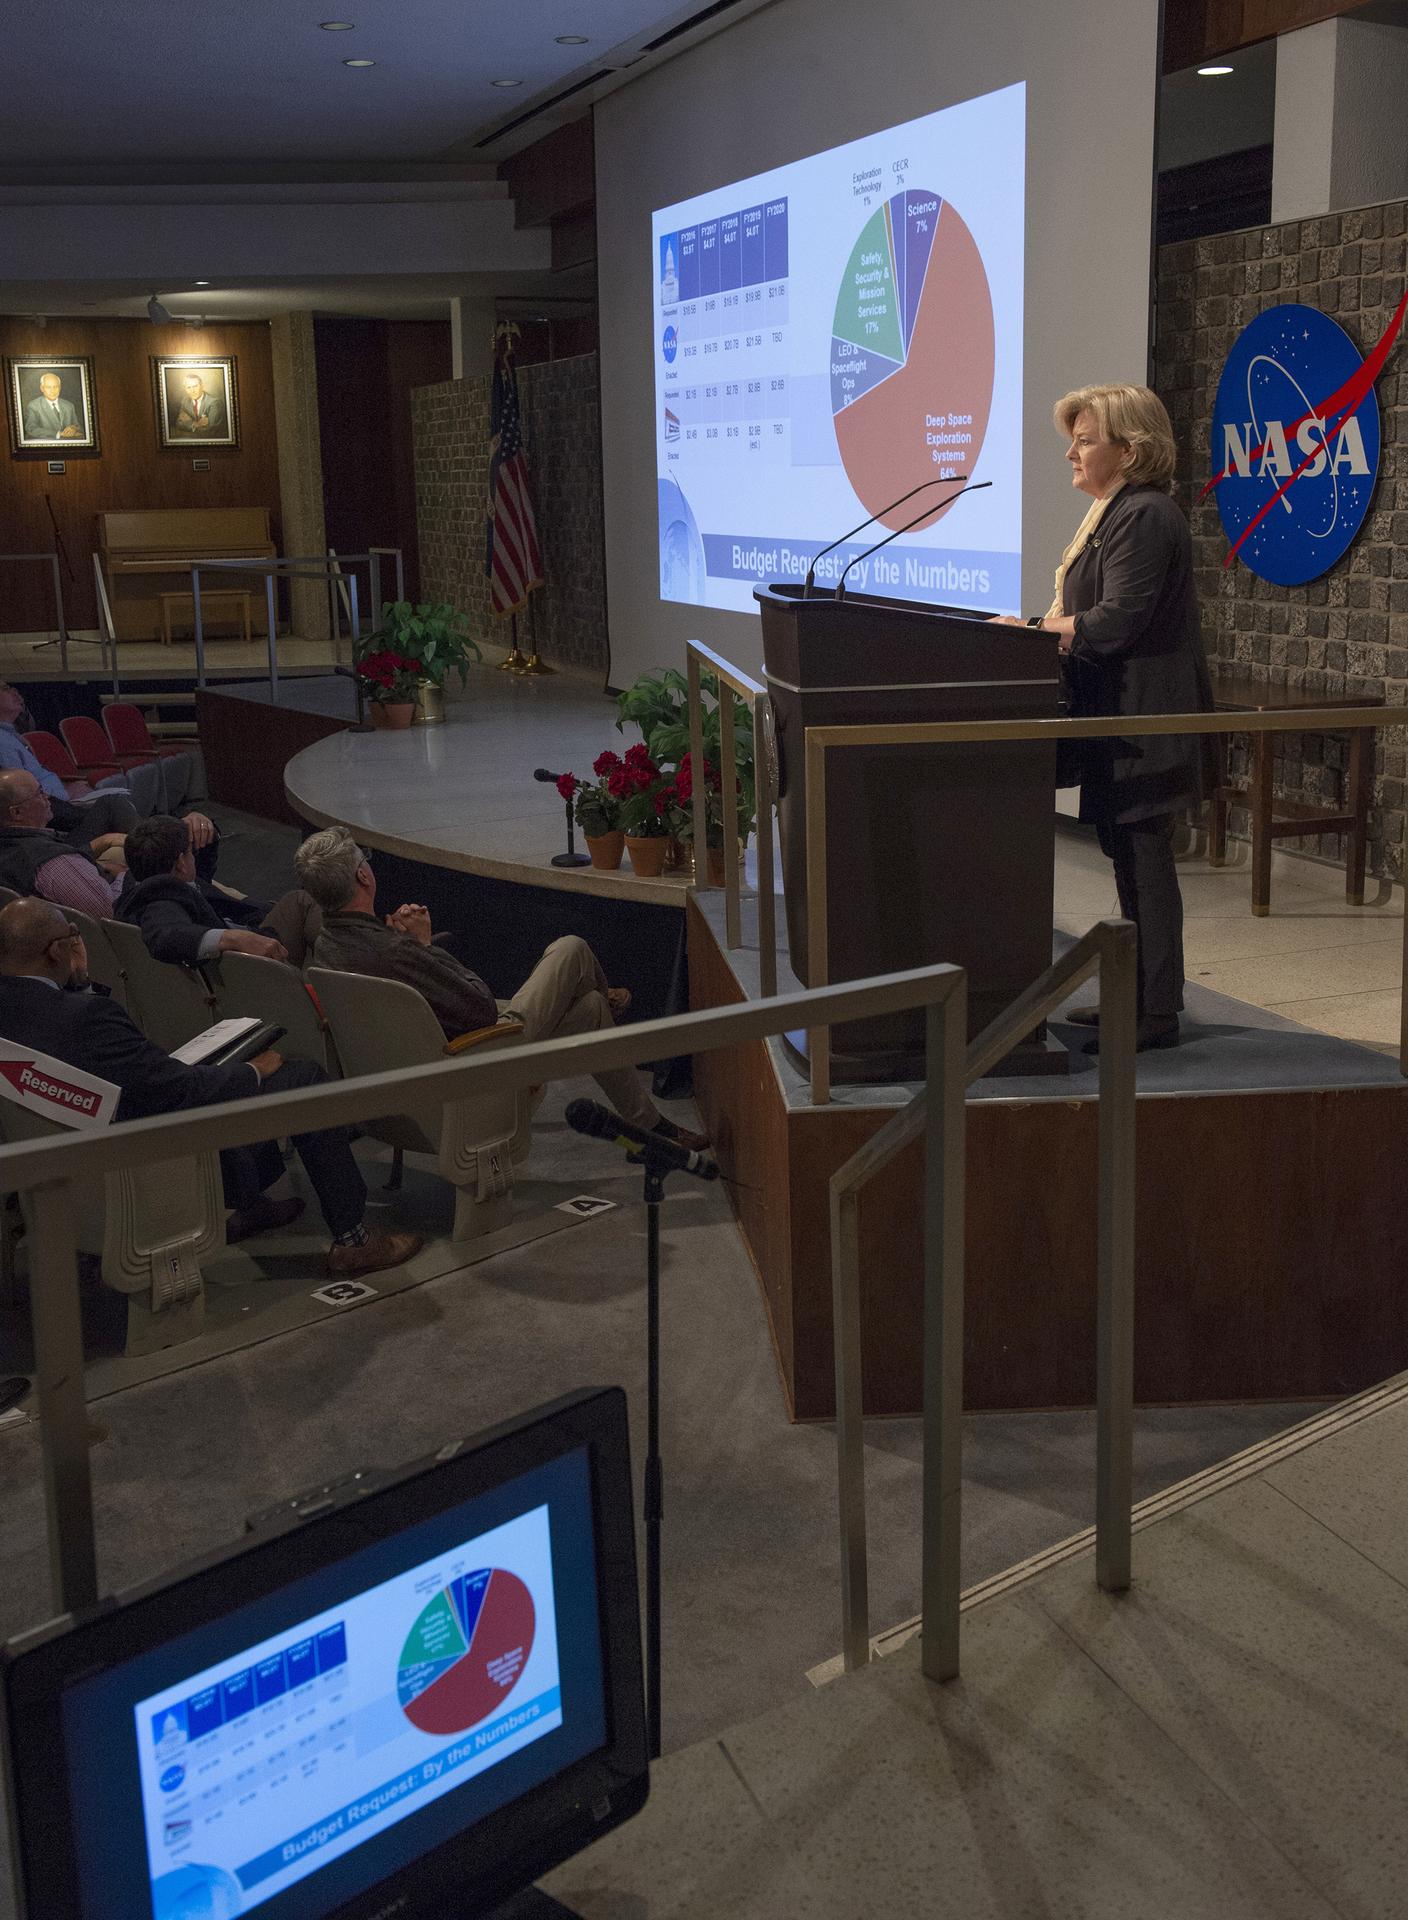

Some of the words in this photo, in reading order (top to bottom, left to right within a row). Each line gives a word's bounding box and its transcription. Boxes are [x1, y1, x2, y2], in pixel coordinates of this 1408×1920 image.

[892, 159, 909, 172] CECR
[852, 167, 882, 184] Exploration
[853, 181, 882, 196] Technology
[766, 203, 785, 217] FY2020
[907, 200, 937, 217] Science
[916, 220, 928, 233] 7%
[855, 270, 883, 285] Security
[858, 286, 886, 299] Mission
[857, 304, 887, 318] Services
[865, 322, 879, 334] 17%
[831, 359, 867, 376] Spaceflight
[842, 377, 855, 390] Ops
[925, 414, 946, 427] Deep
[947, 412, 972, 427] Space
[926, 431, 971, 445] Exploration
[1223, 416, 1371, 480] NASA
[932, 449, 966, 464] Systems
[732, 544, 777, 578] Budget
[848, 553, 870, 589] By
[873, 559, 900, 585] the
[905, 560, 990, 593] Numbers
[20, 1068, 96, 1110] Reserved
[569, 1199, 611, 1212] A
[282, 1817, 345, 1861] Budget
[348, 1773, 419, 1822] Request:
[422, 1755, 444, 1779] By
[447, 1743, 472, 1764] the
[474, 1703, 541, 1748] Numbers
